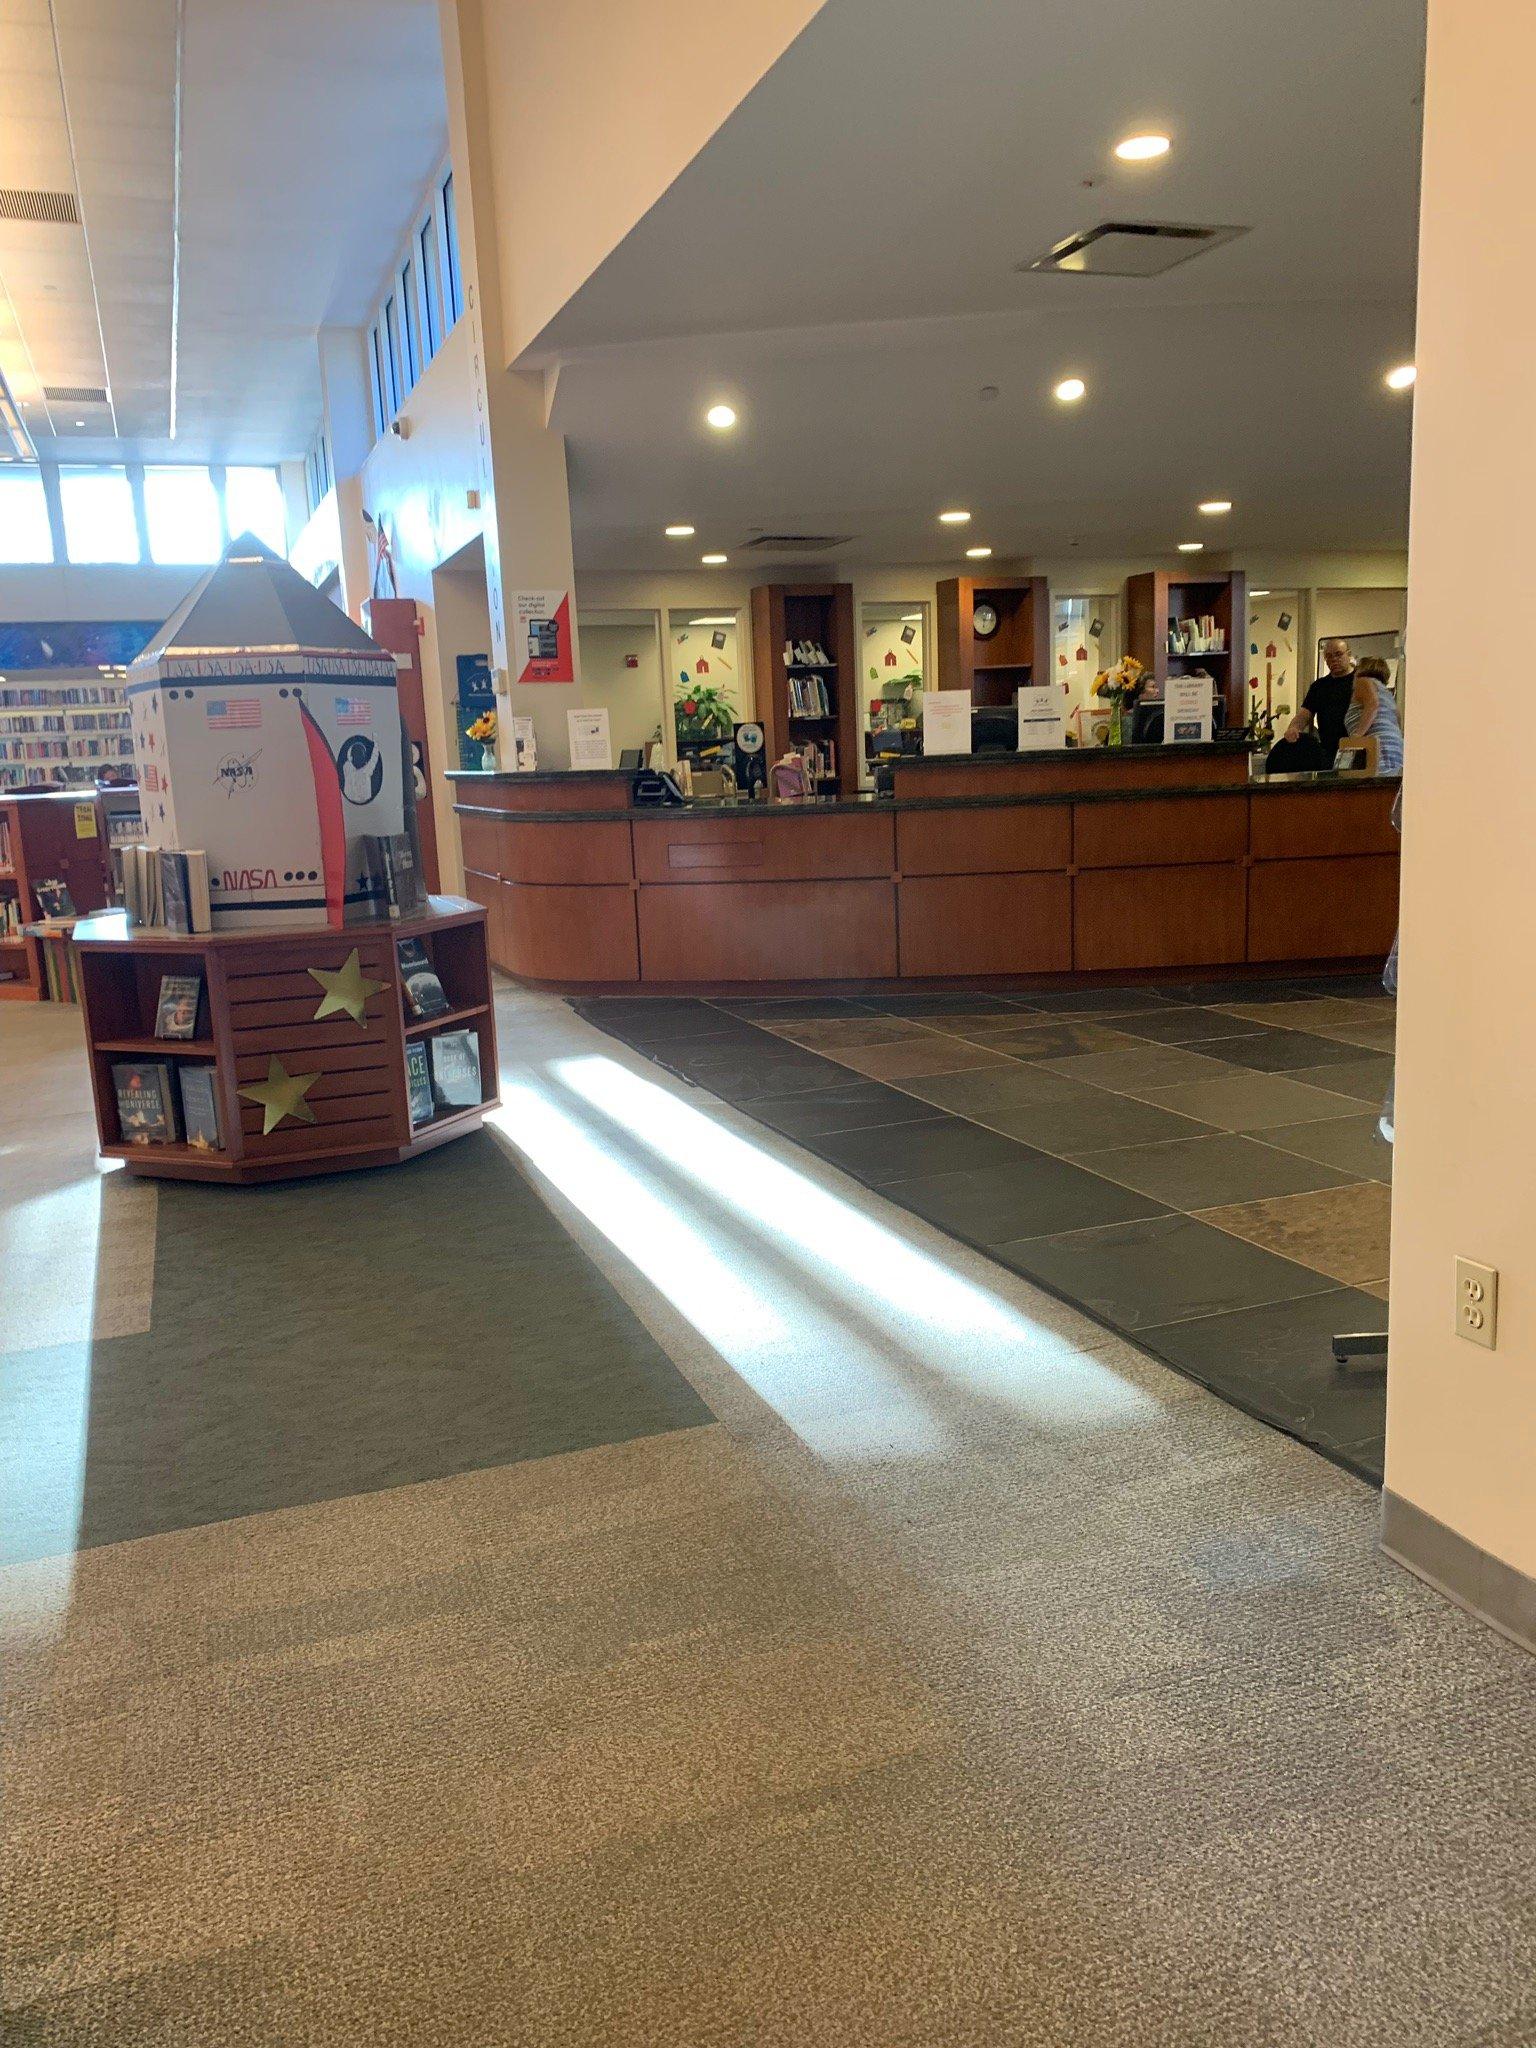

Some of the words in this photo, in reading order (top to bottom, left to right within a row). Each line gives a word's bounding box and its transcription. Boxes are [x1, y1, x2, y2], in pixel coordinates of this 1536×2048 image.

[468, 284, 502, 644] CIRCULION
[220, 766, 253, 778] NASA
[223, 868, 278, 891] NASA
[433, 1065, 478, 1081] UNIERSES
[117, 1088, 157, 1099] REVEALING
